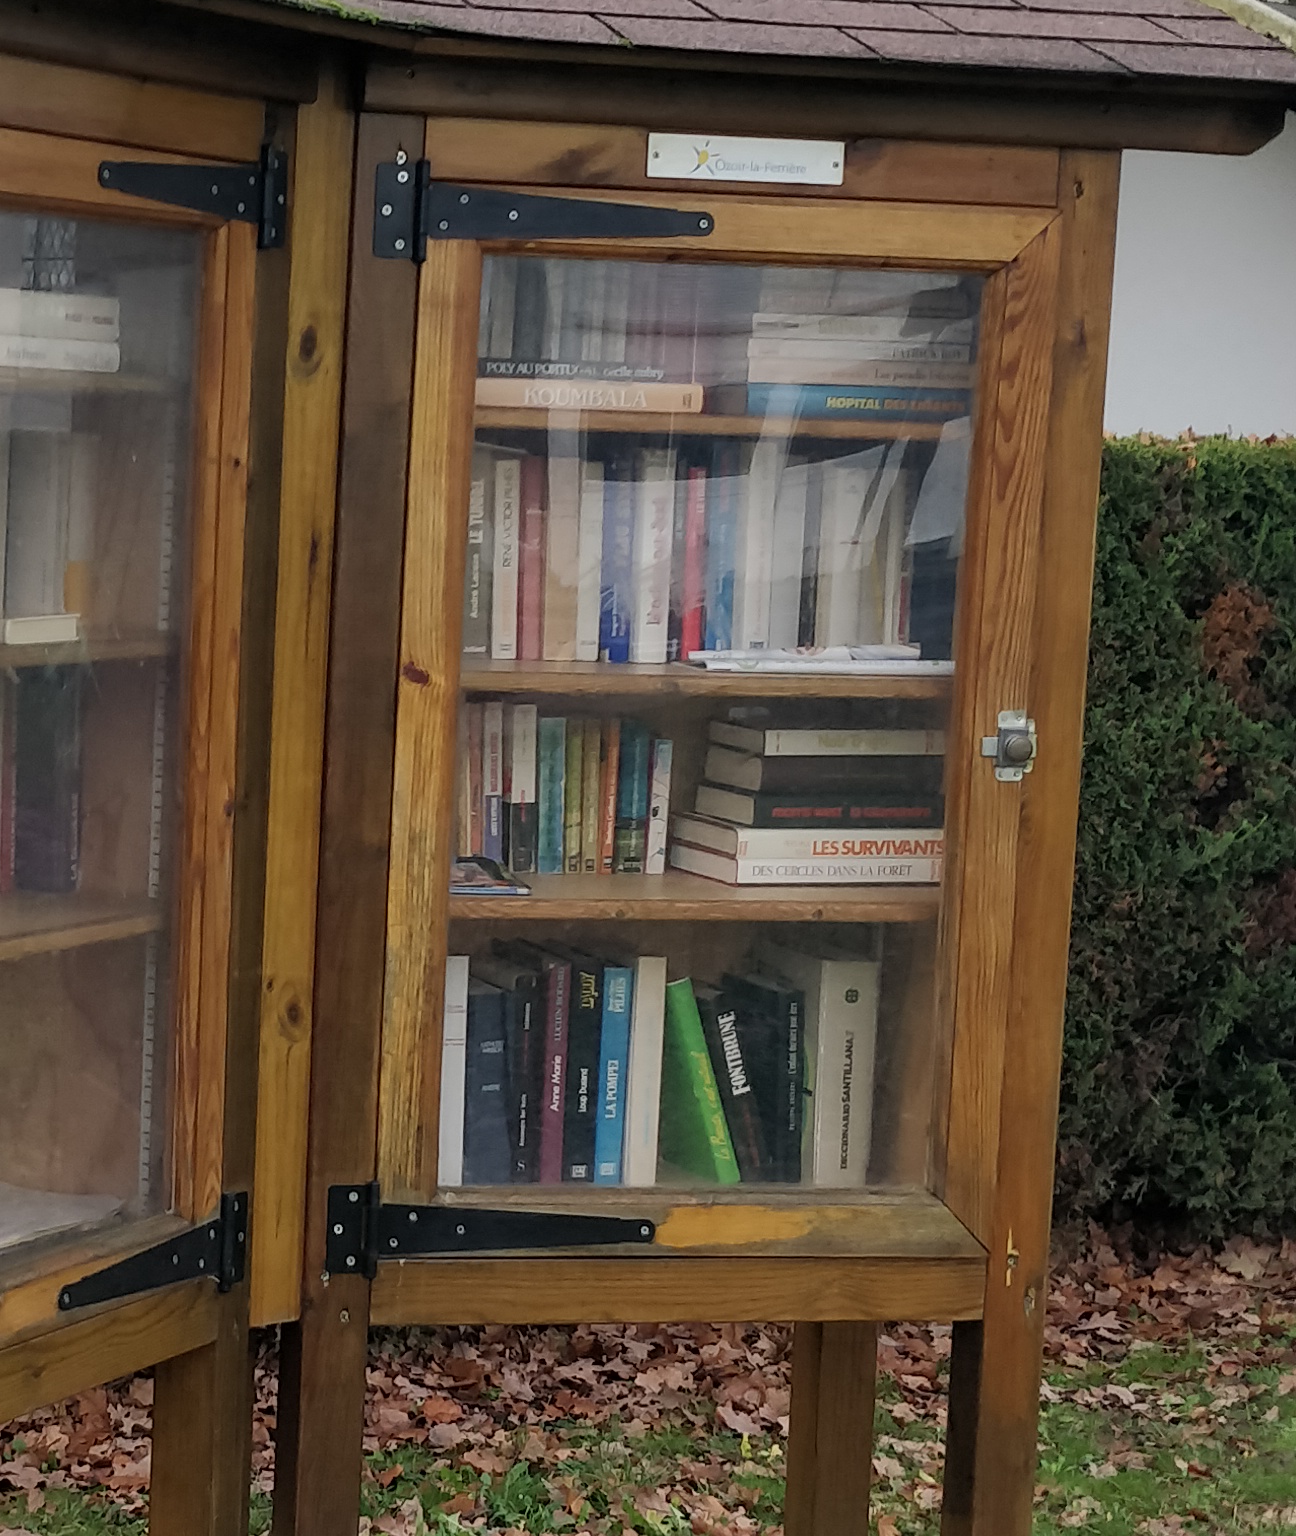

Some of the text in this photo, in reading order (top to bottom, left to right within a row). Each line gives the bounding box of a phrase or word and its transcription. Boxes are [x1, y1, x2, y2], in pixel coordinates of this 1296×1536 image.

[517, 364, 533, 375] AU
[523, 386, 648, 408] KOUMBALA
[826, 396, 881, 410] HOPITAL
[468, 529, 484, 545] LE
[812, 840, 839, 856] LES
[841, 840, 944, 856] SURVIVANTS
[752, 865, 773, 877] DES
[775, 865, 824, 877] CERCLES
[827, 865, 857, 877] DANS
[859, 865, 873, 876] LA
[717, 1010, 751, 1096] FONTBRUNE
[841, 1037, 854, 1104] SANTILLANA
[549, 1055, 563, 1112] Anne Marie
[605, 1103, 616, 1119] LA
[840, 1103, 851, 1170] DICCIONARIO
